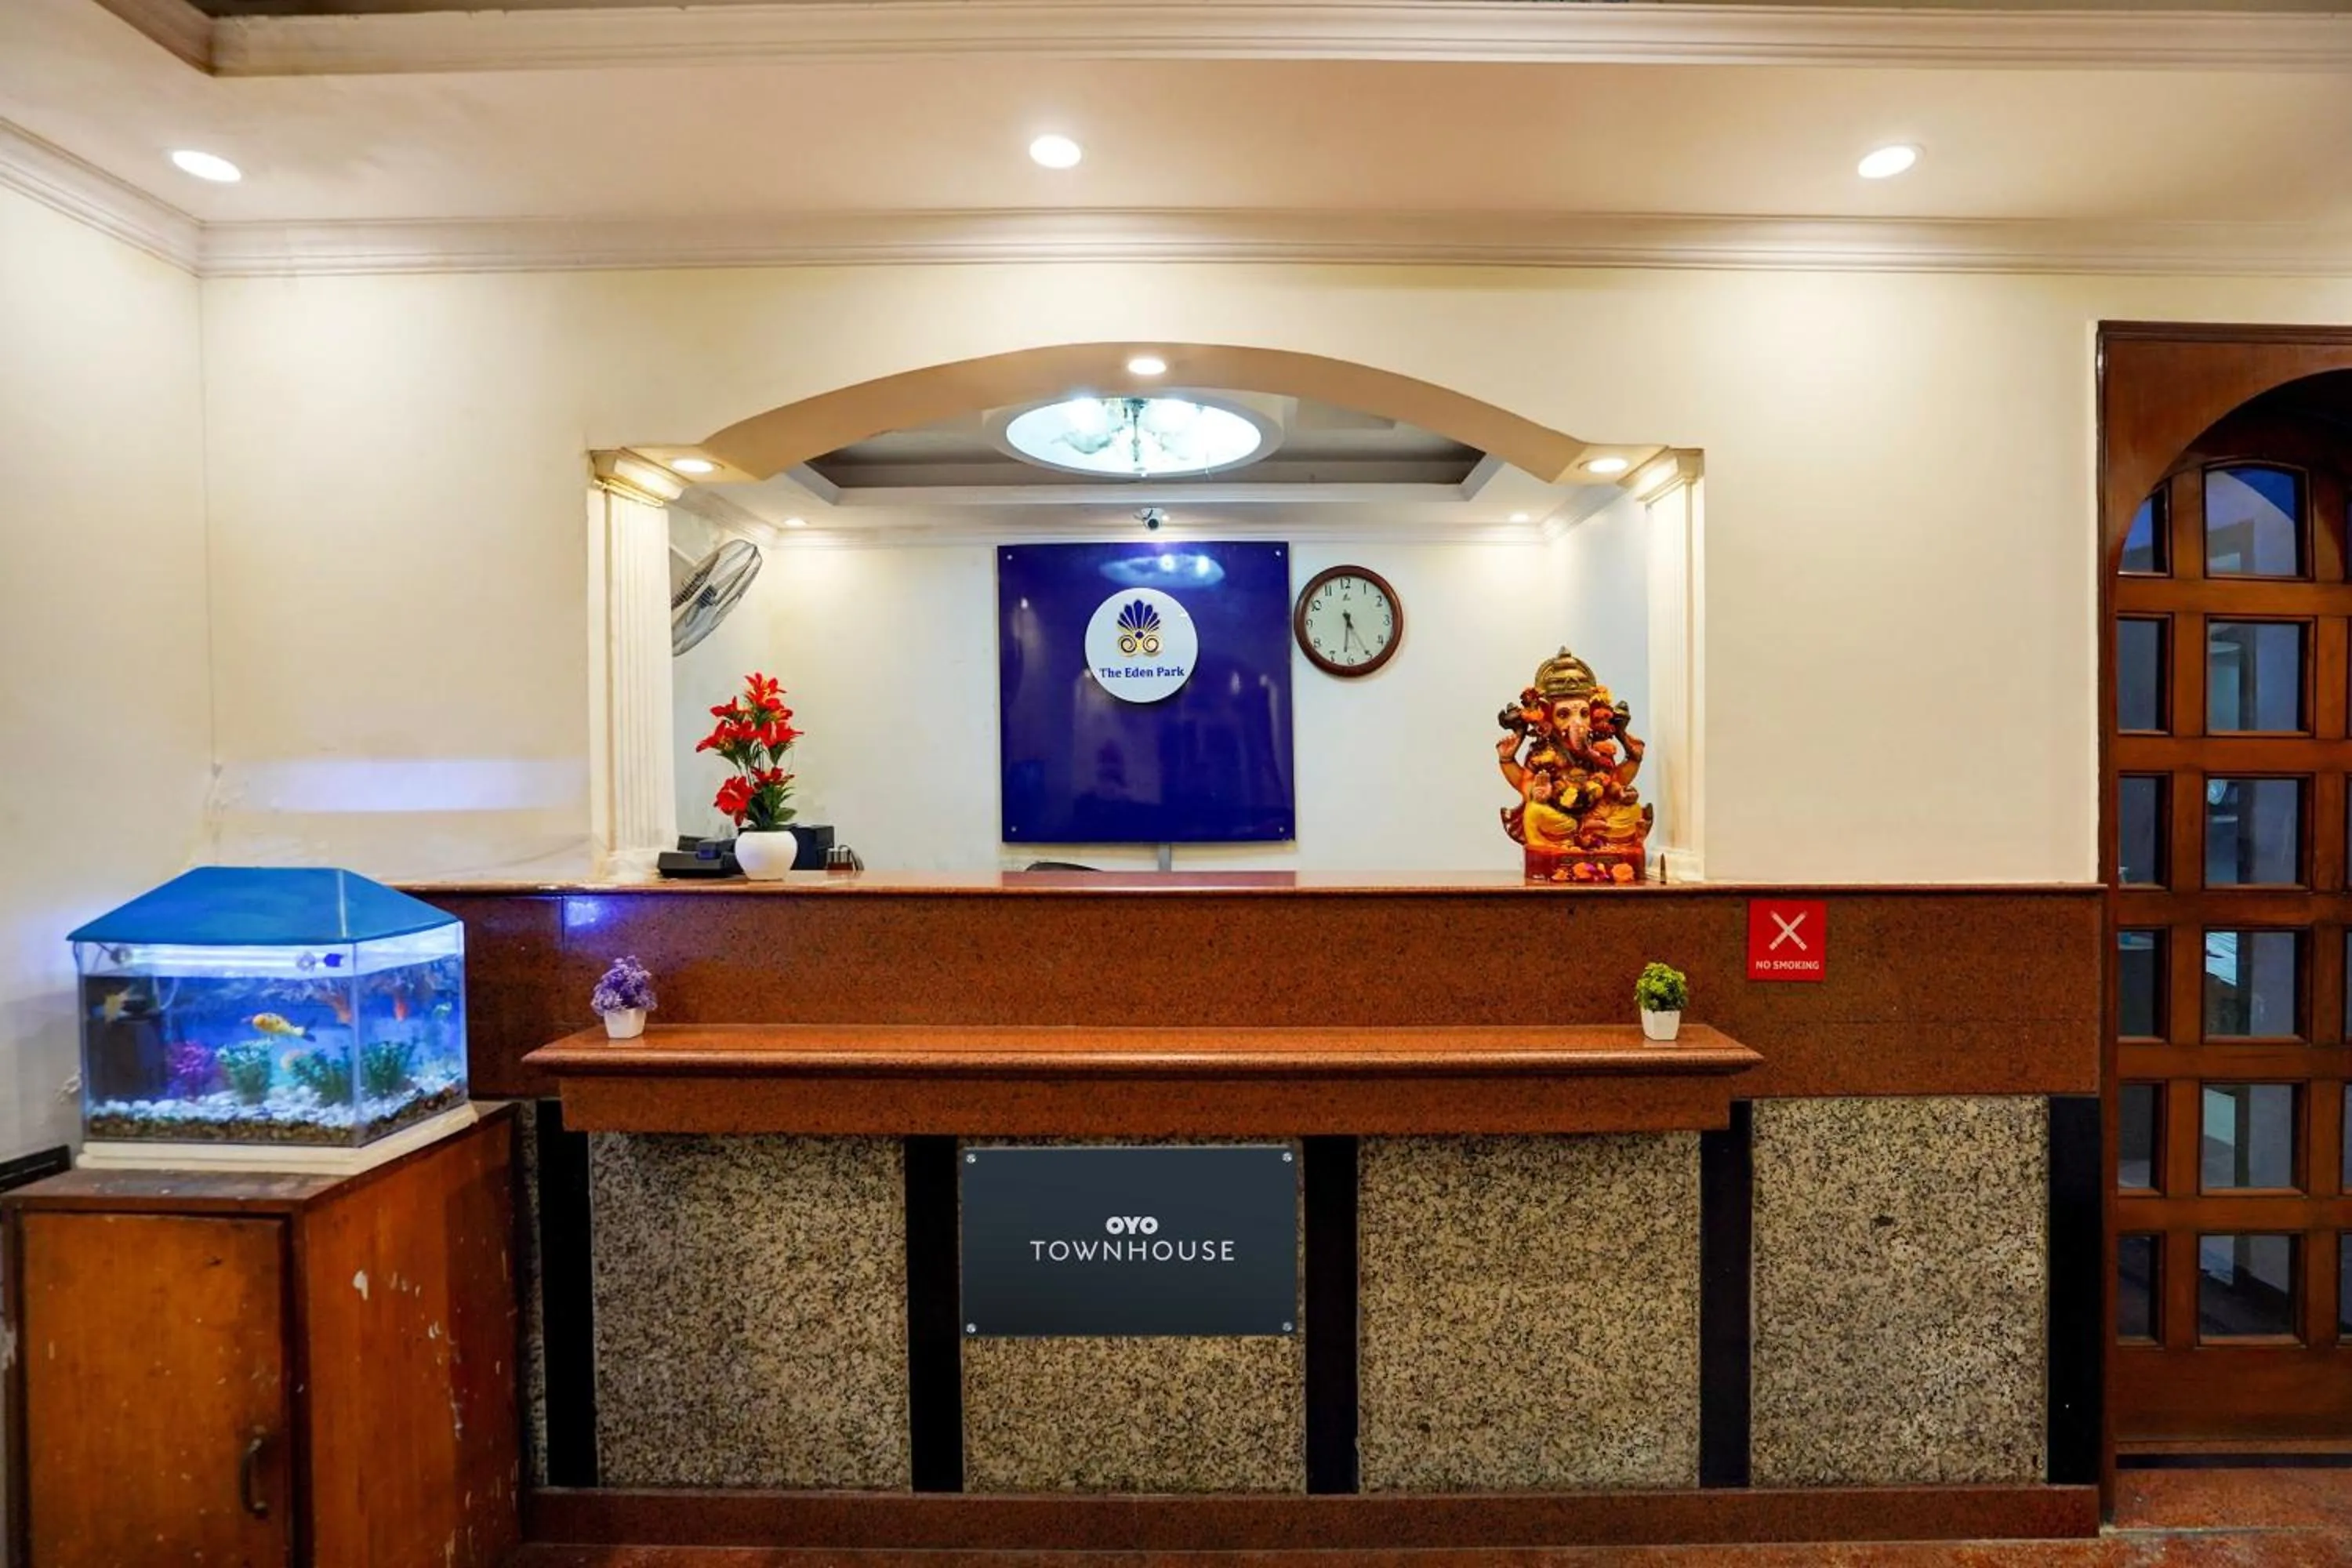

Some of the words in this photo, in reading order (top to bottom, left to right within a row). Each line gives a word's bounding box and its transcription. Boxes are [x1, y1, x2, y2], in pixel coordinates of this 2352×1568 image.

[1099, 667, 1122, 678] The
[1125, 667, 1153, 677] Eden
[1156, 666, 1185, 677] Park
[1755, 960, 1771, 970] NO
[1773, 960, 1820, 970] SMOKING
[1105, 1216, 1159, 1235] OYO
[1029, 1240, 1236, 1261] TOWNHOUSE
